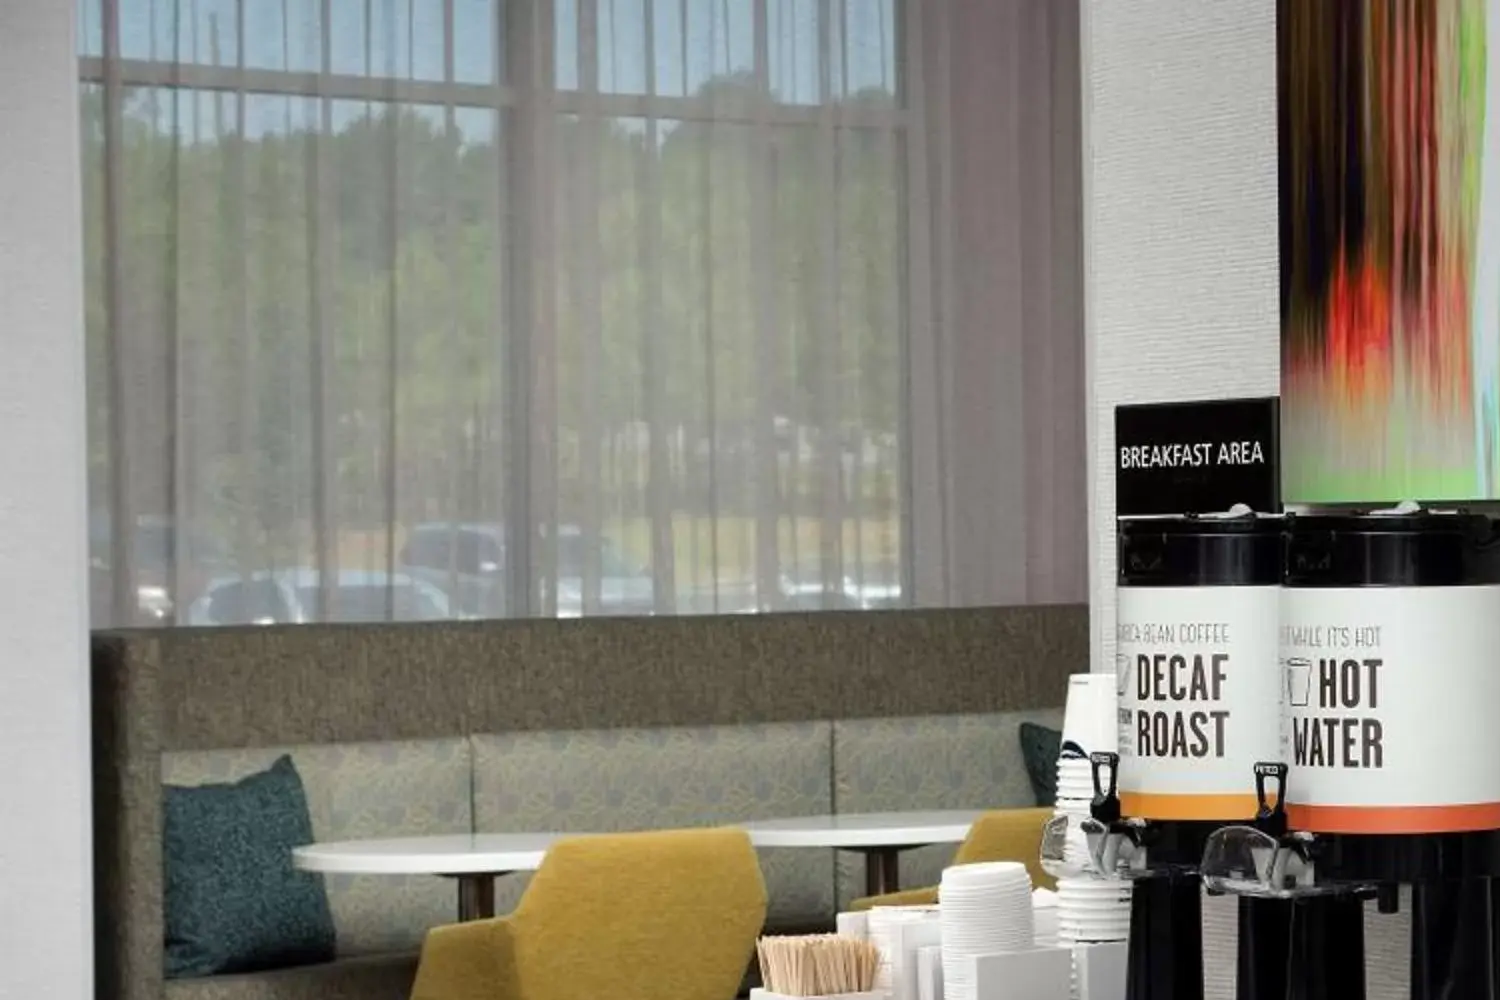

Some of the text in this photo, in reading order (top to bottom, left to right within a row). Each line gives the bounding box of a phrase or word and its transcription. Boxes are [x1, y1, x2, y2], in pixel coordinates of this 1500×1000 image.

[1120, 441, 1265, 469] BREAKFAST AREA
[1179, 623, 1230, 644] COFFEE
[1327, 626, 1349, 648] IT'S
[1355, 626, 1382, 647] HOT
[1136, 653, 1230, 701] DECAF
[1319, 657, 1384, 709] HOT
[1137, 709, 1231, 758] ROAST
[1292, 717, 1384, 768] WATER
